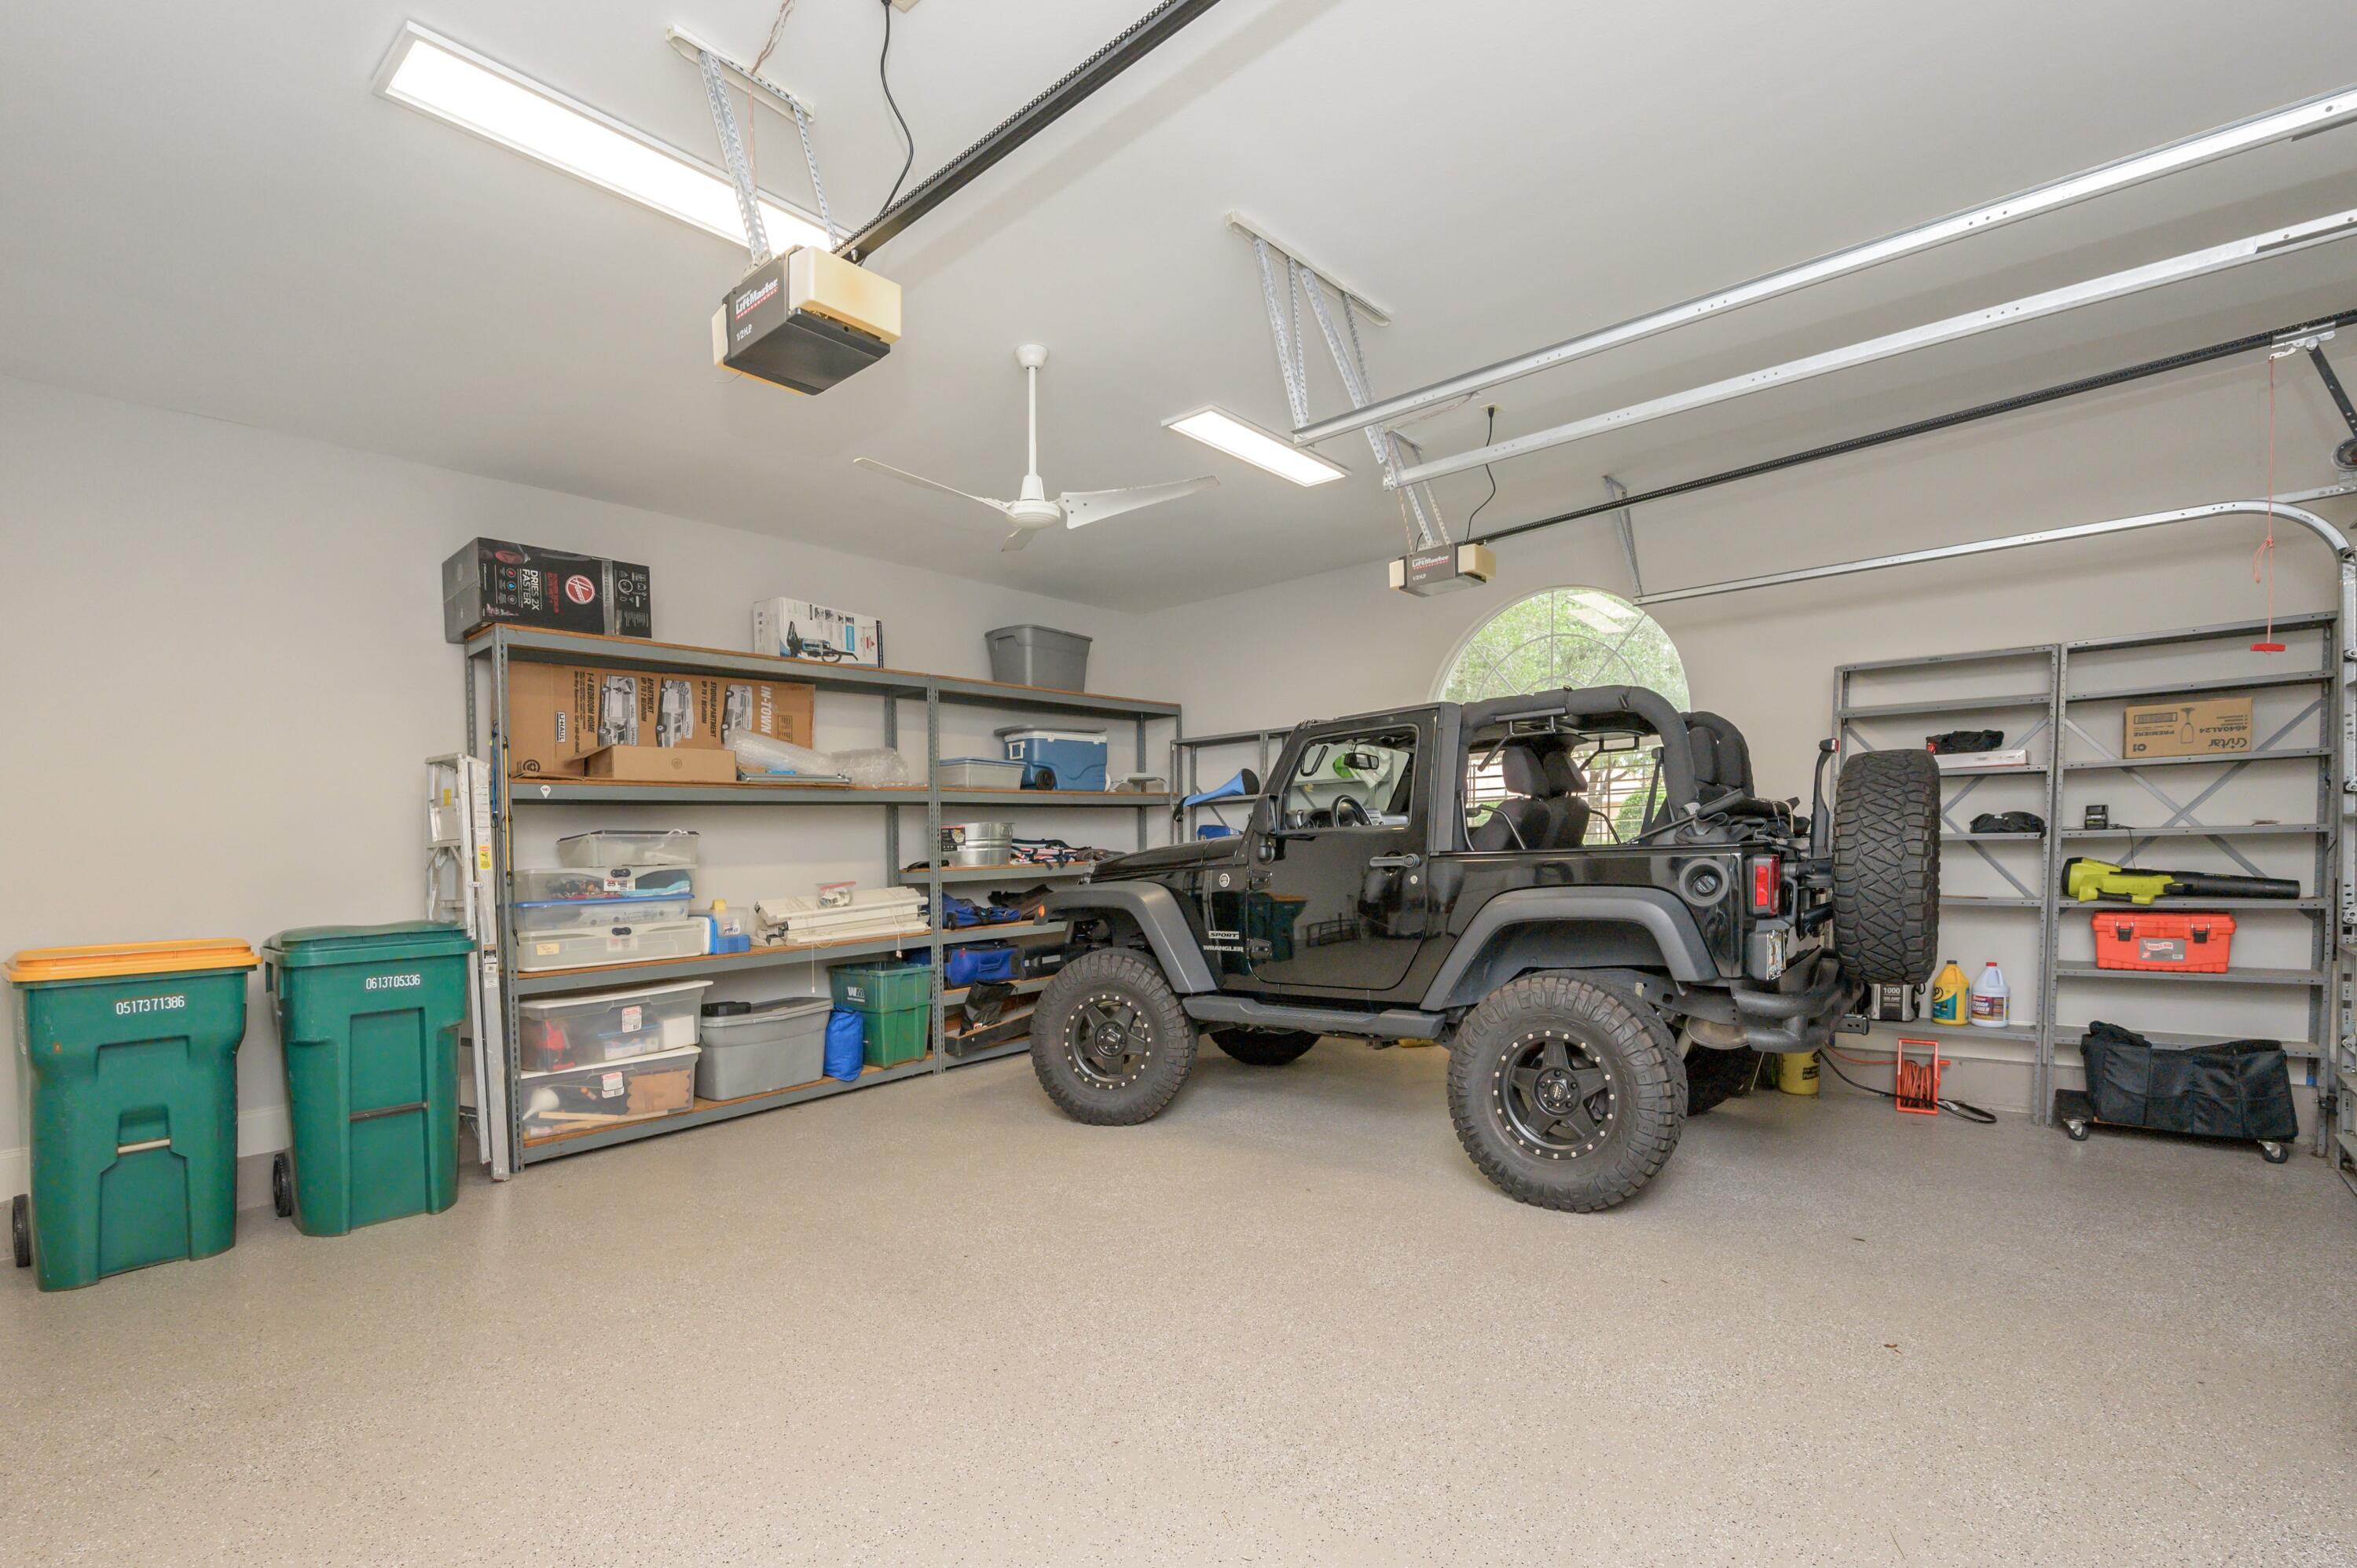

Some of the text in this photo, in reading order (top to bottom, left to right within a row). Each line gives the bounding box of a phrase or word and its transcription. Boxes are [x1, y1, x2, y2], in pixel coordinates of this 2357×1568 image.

[736, 277, 778, 315] LiftMaster
[522, 568, 532, 605] FASTER
[530, 570, 540, 610] DRIES 2X
[646, 677, 654, 715] APARTMENT
[761, 685, 773, 735] IN-TOWN
[587, 715, 596, 734] HOME
[2209, 737, 2248, 749] Cristar
[1202, 944, 1244, 953] WRANGLER
[365, 974, 421, 990] 0613705336
[115, 995, 185, 1015] 0517371386
